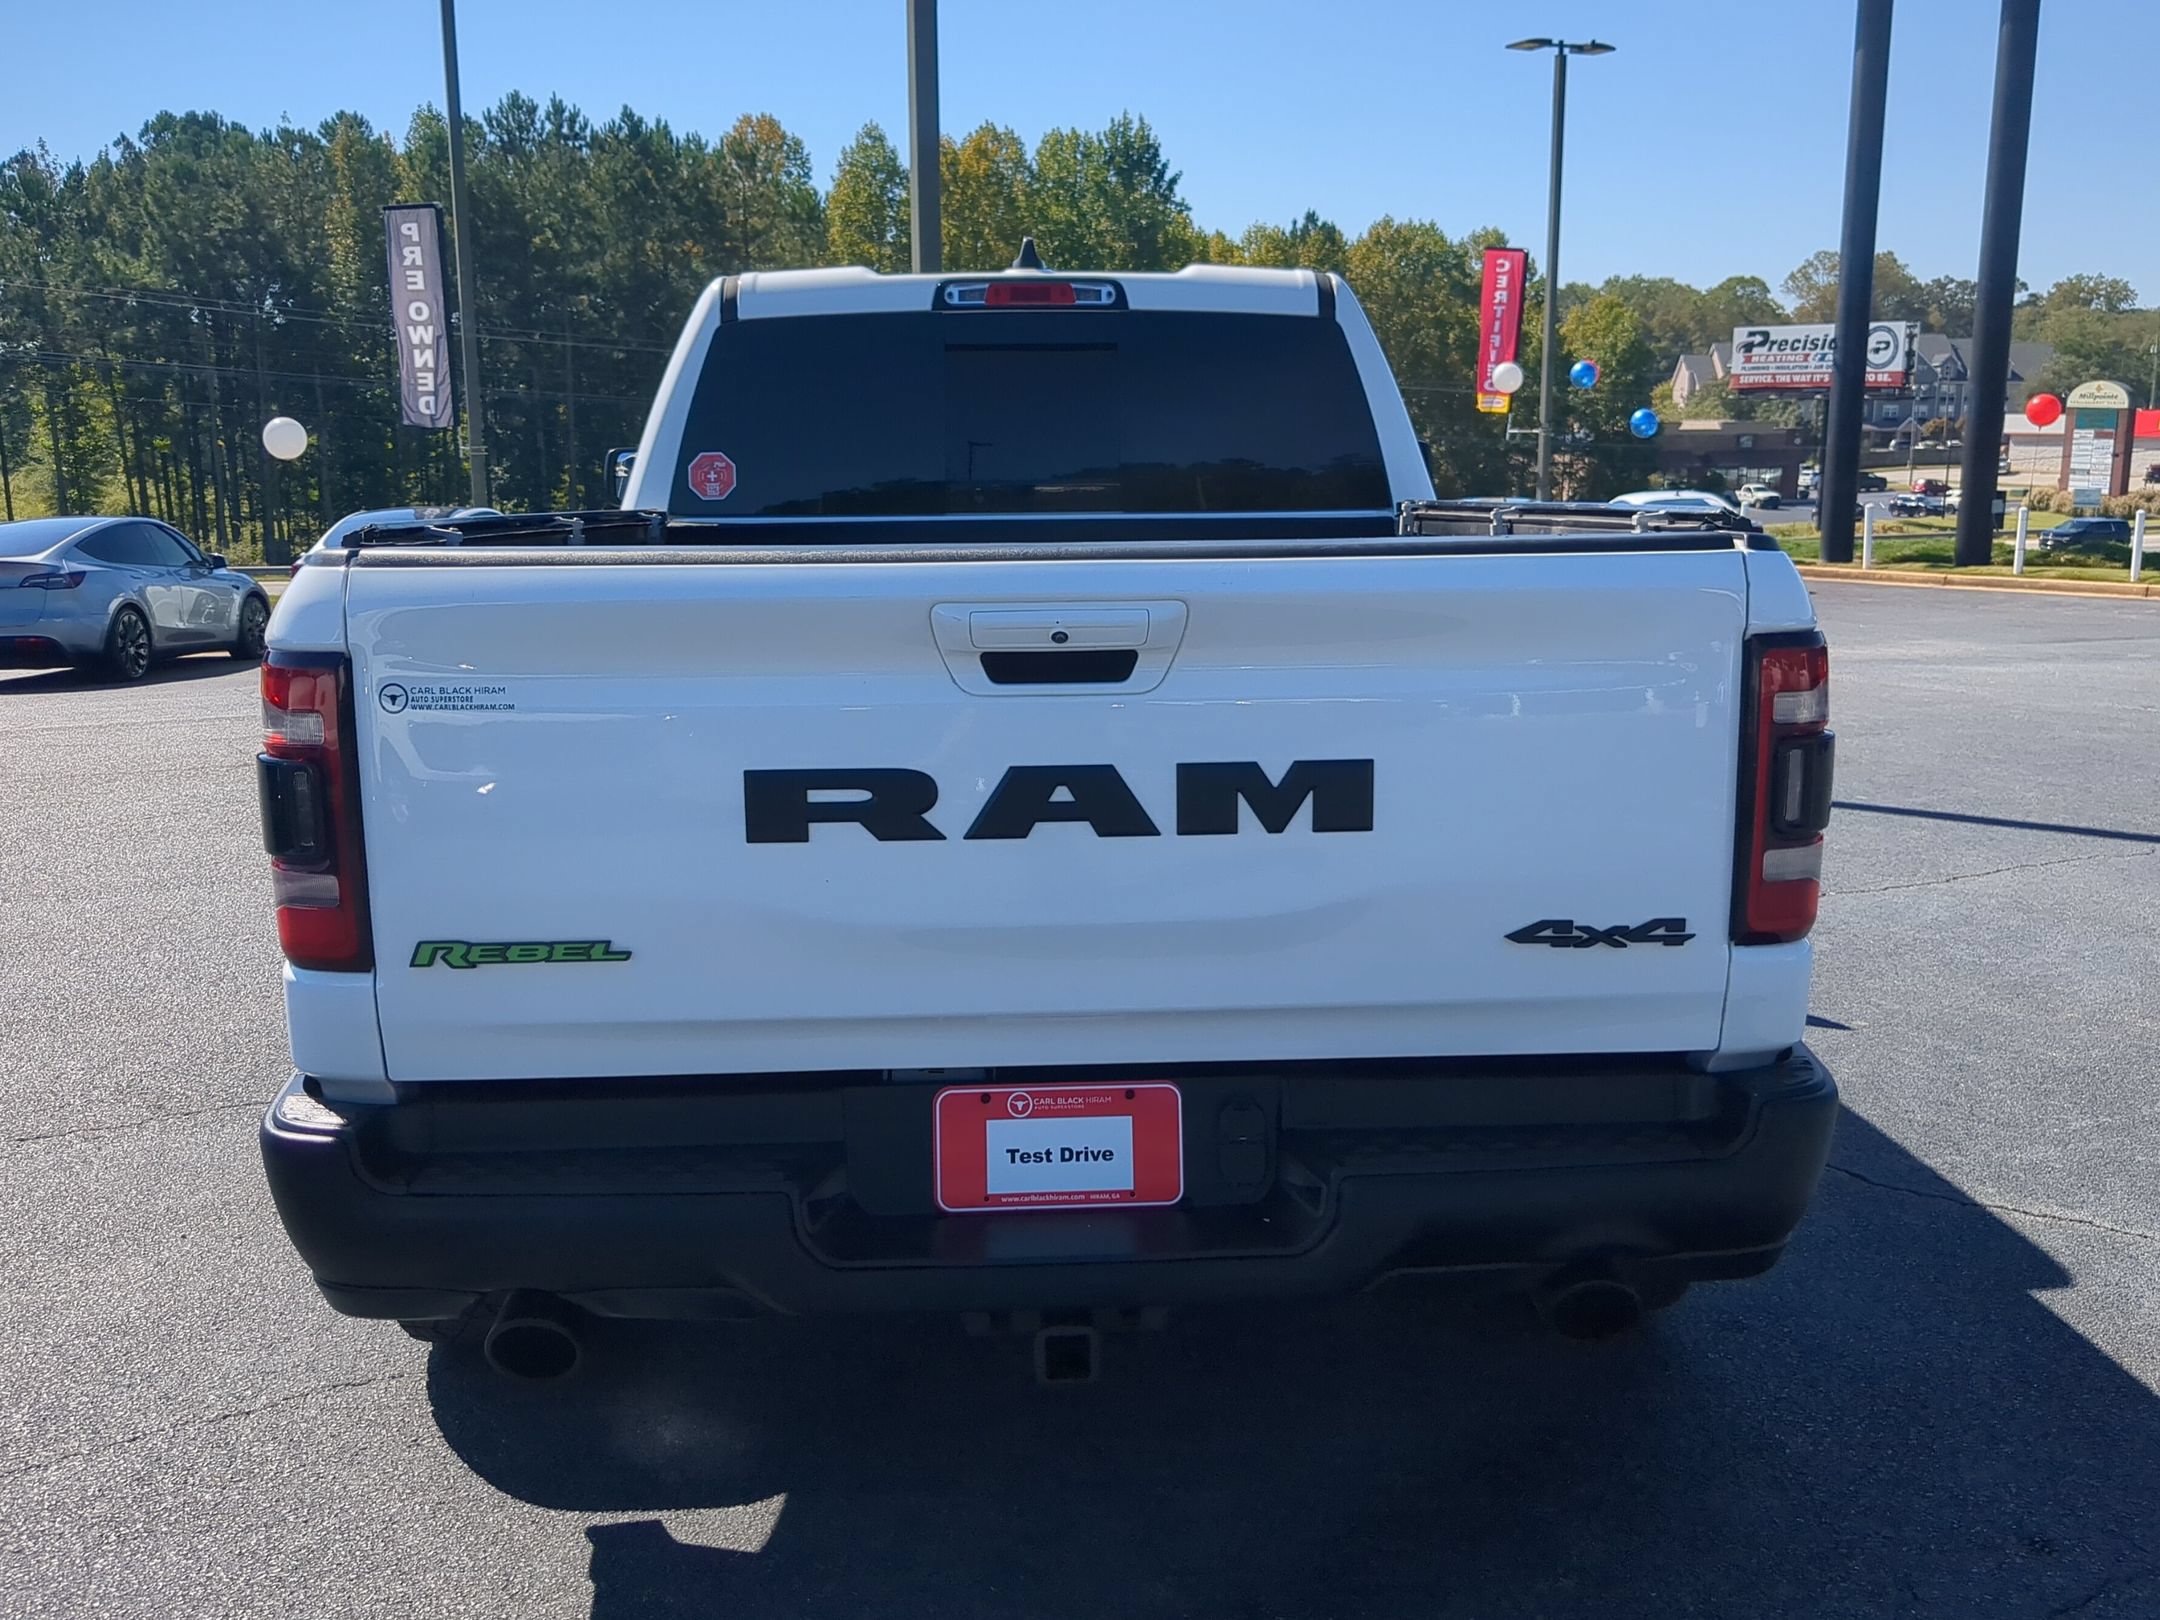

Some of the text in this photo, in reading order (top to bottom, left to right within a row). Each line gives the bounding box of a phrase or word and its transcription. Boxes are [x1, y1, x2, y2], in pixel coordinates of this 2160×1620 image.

[1736, 330, 1839, 353] Precisio
[1751, 354, 1804, 363] HEATING
[1775, 375, 1792, 383] THE
[1792, 374, 1810, 382] WAY
[410, 687, 506, 695] CARL BLACK HIRAM
[743, 759, 1374, 843] RAM
[1086, 1096, 1112, 1104] HIRAM
[1006, 1146, 1114, 1164] Test Drive
[1001, 1193, 1085, 1202] www.carlblackhiram.com
